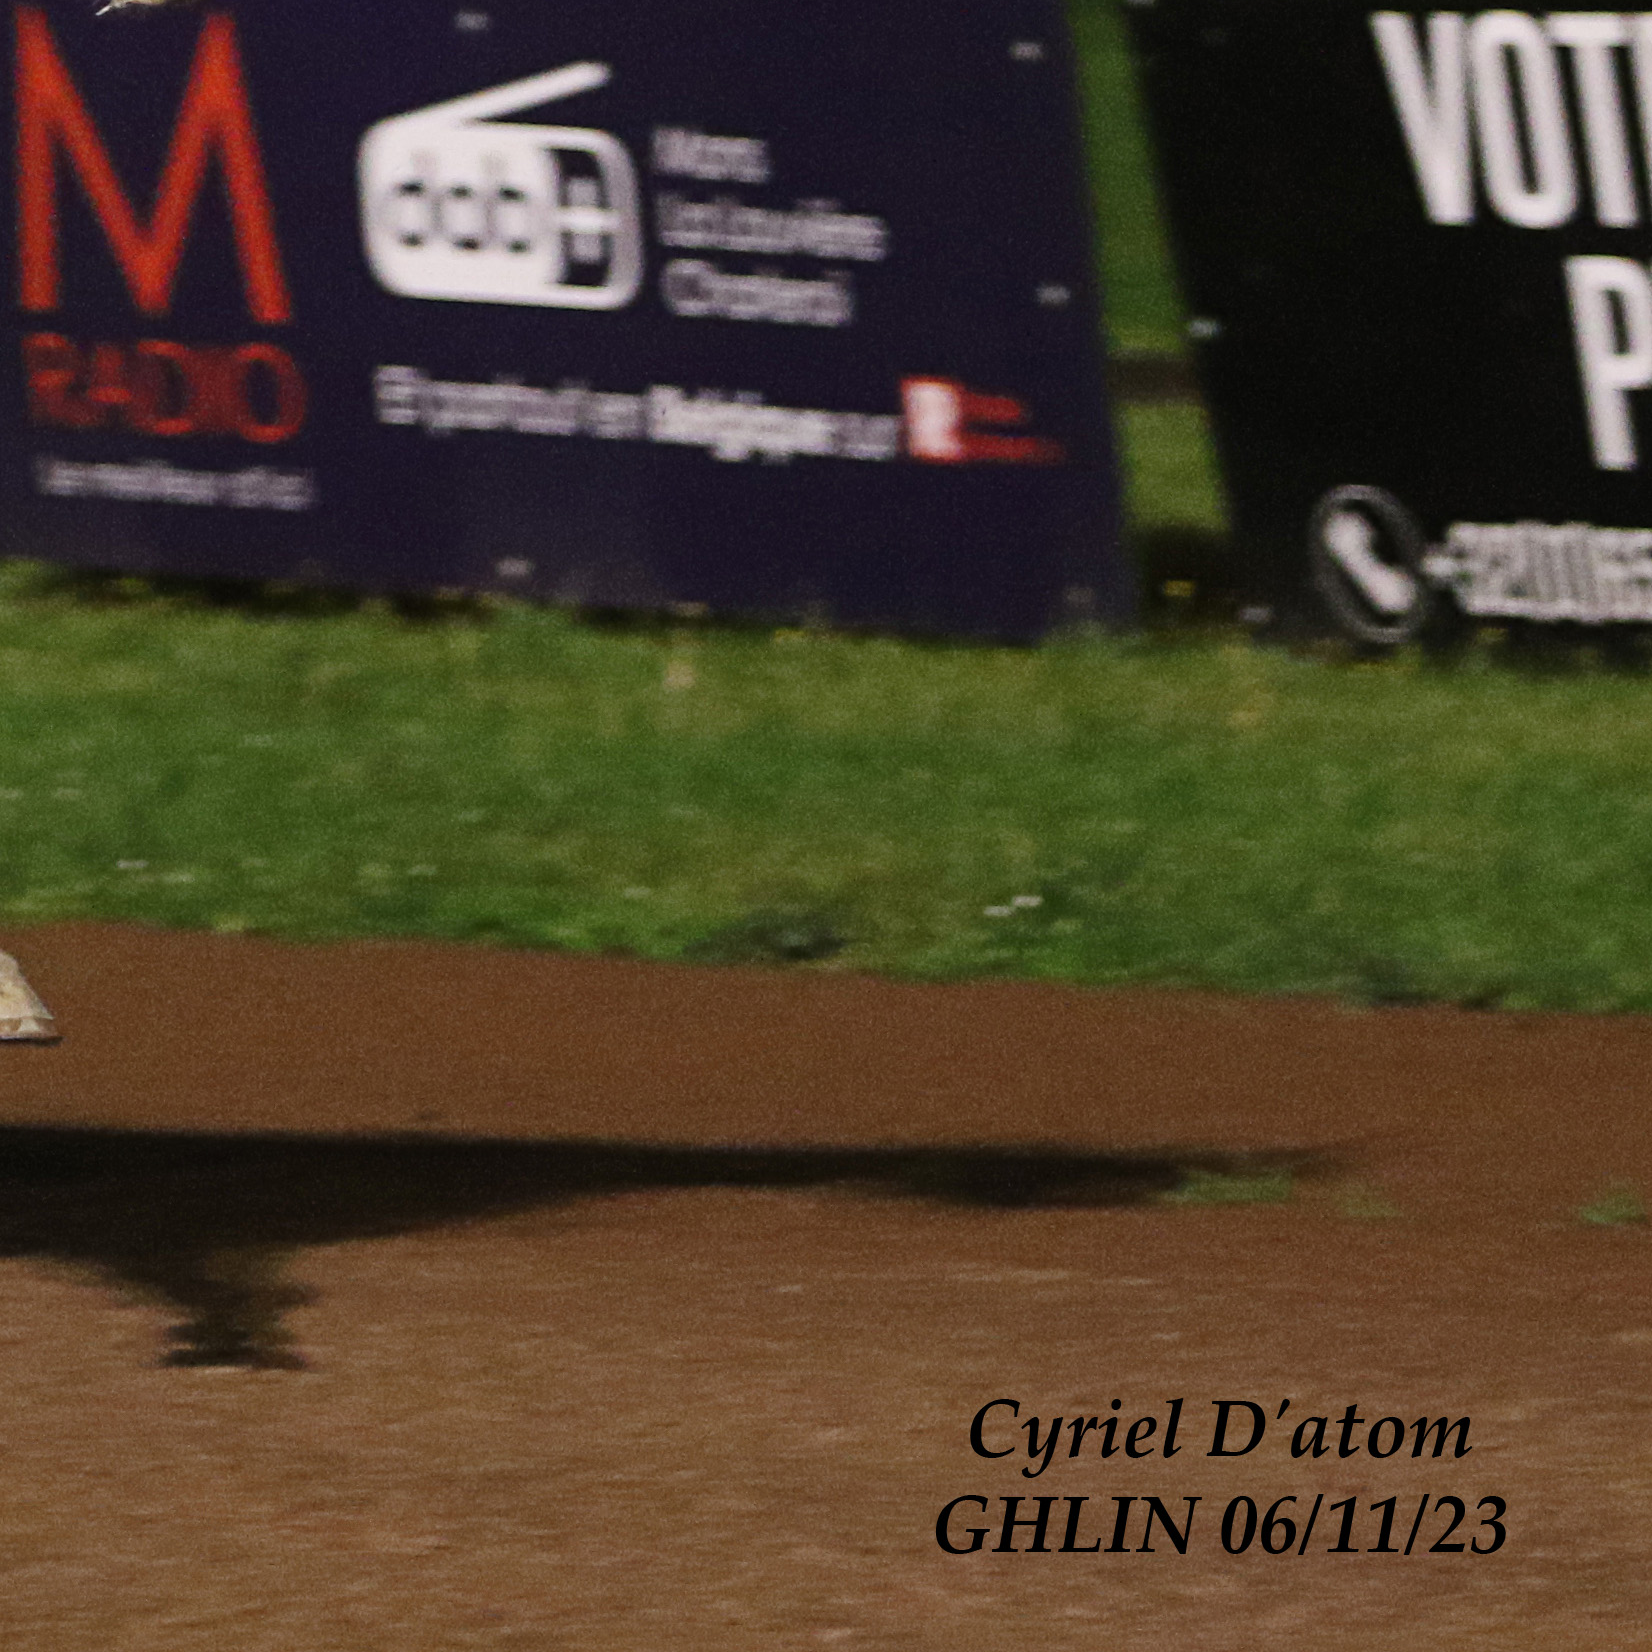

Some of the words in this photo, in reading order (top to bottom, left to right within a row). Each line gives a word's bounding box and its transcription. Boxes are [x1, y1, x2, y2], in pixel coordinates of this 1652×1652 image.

[13, 2, 292, 327] M
[1367, 8, 1652, 229] VOT
[22, 331, 309, 444] RADIO
